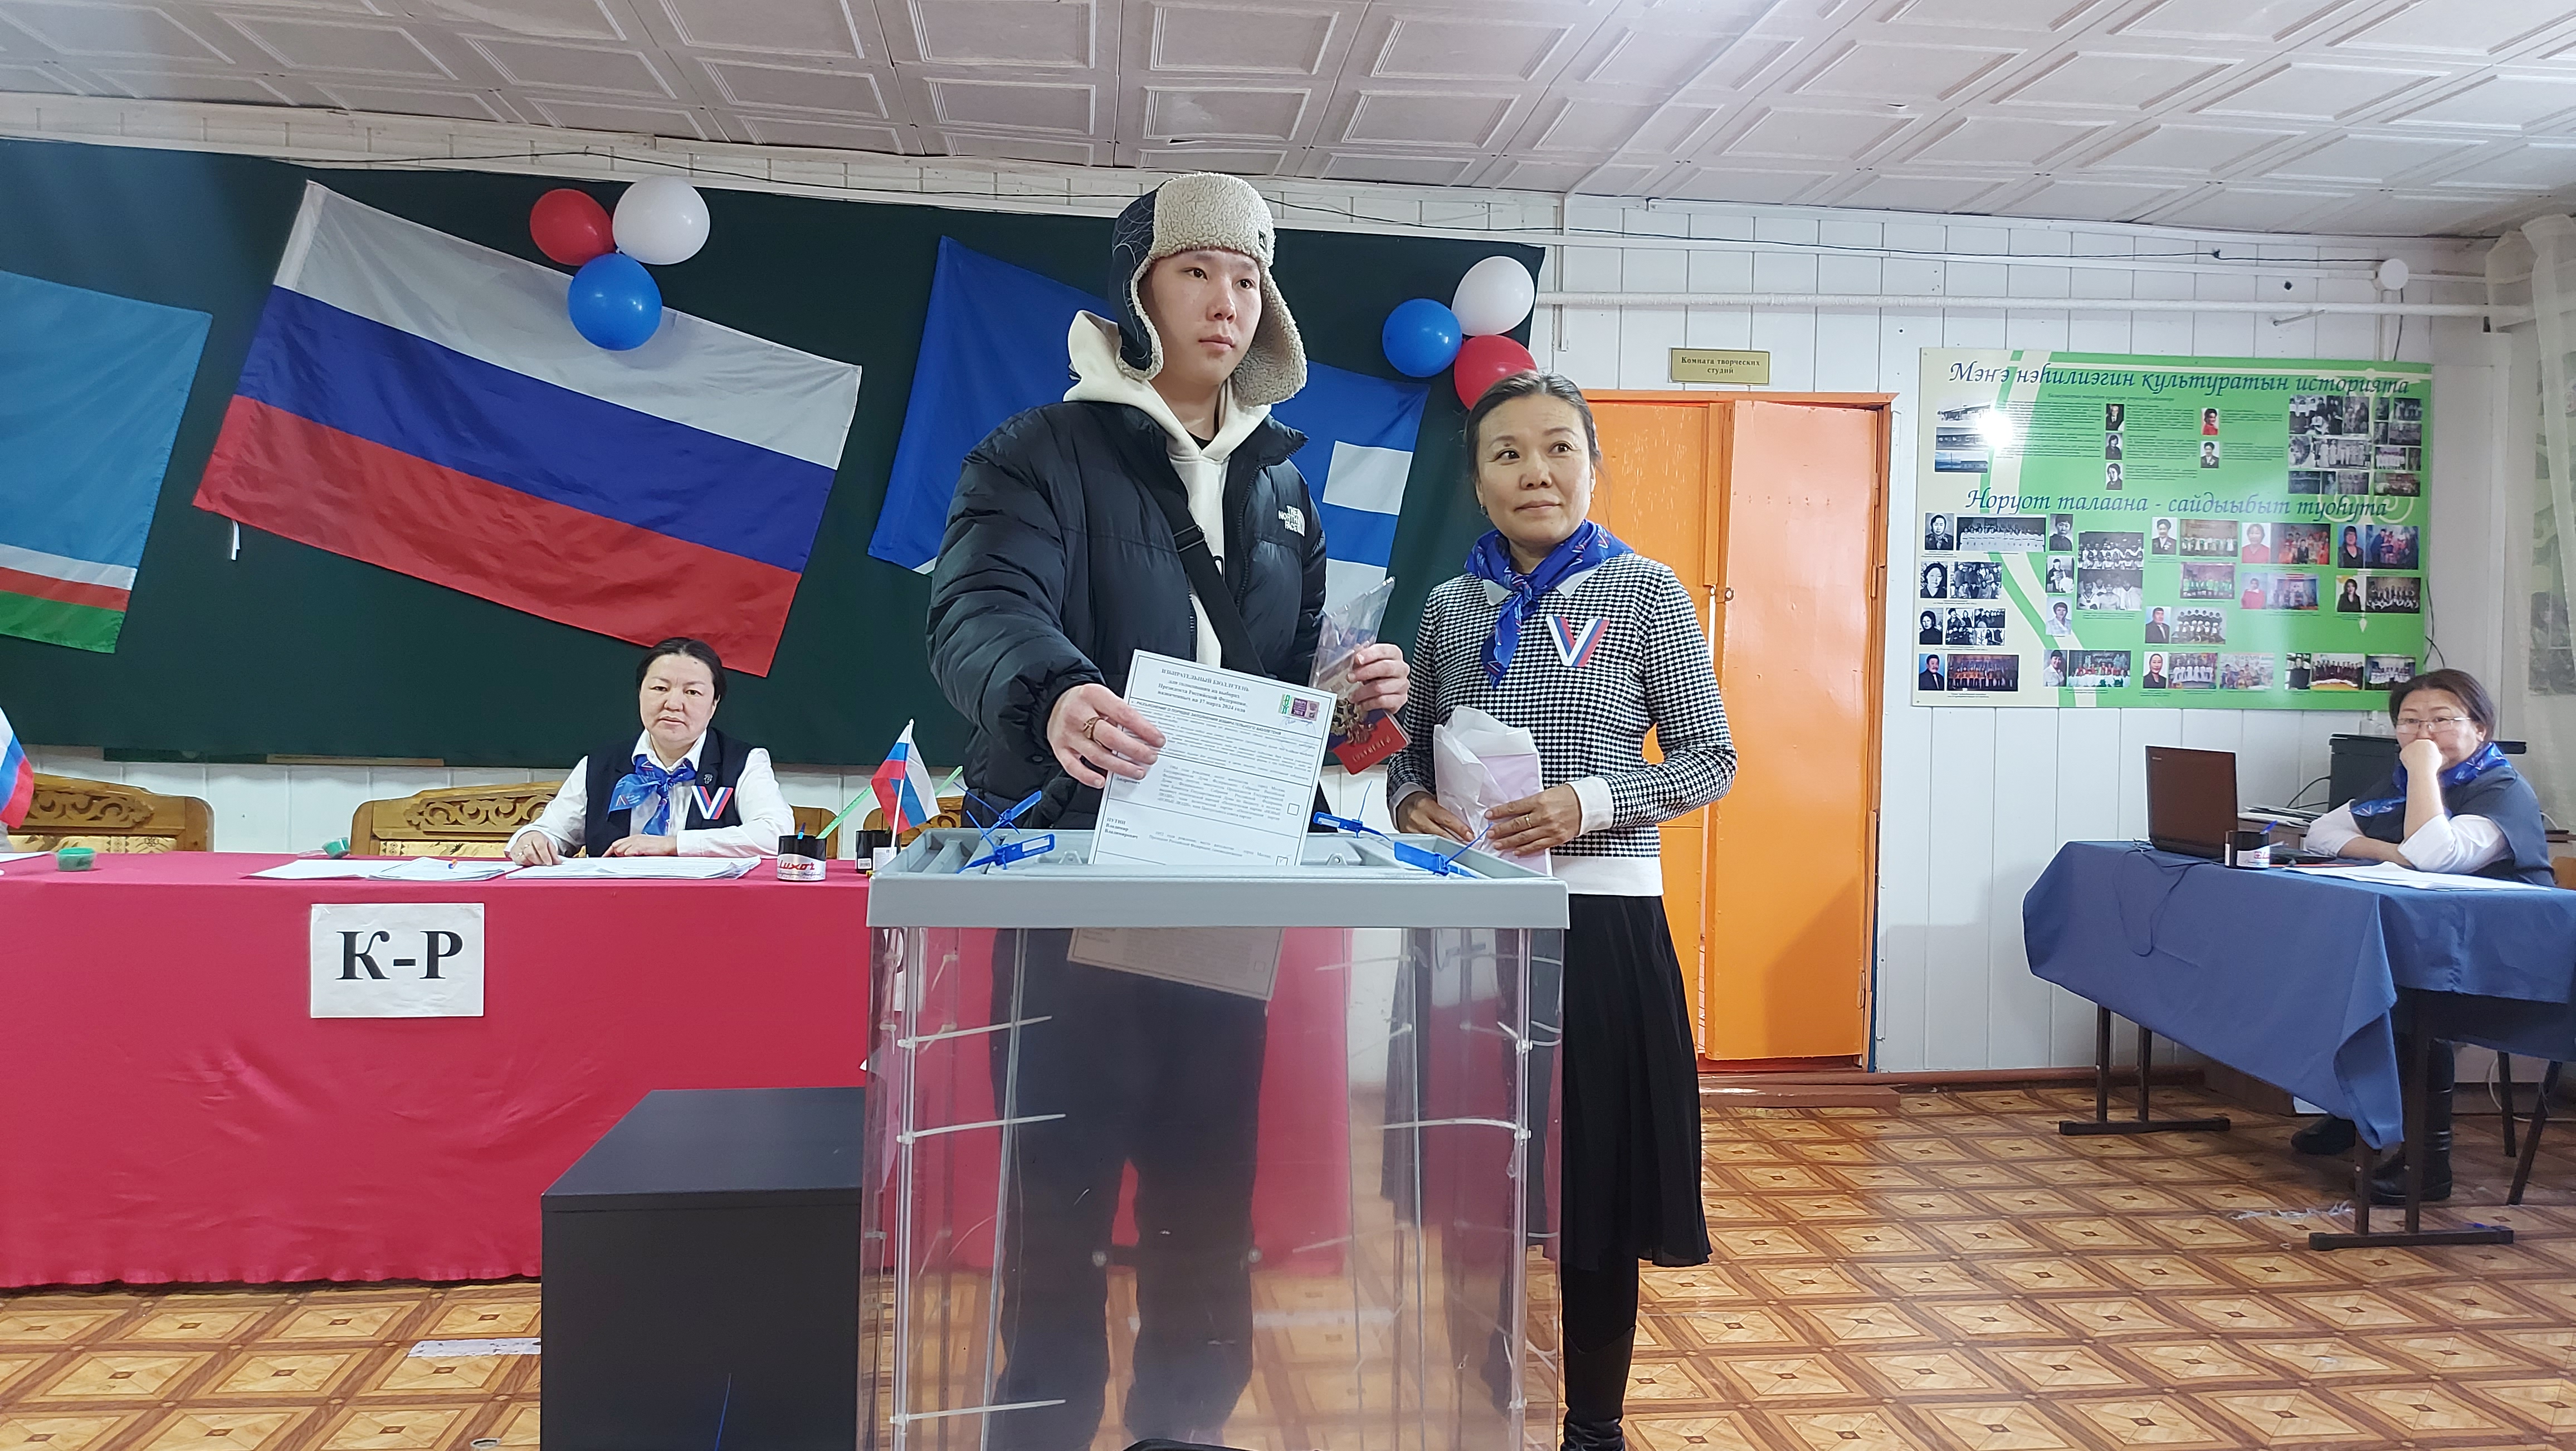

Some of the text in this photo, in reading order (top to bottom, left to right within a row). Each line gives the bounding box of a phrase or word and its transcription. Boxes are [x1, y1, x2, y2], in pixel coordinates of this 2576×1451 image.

[1707, 367, 1734, 375] студий
[2142, 373, 2289, 395] культуратын
[2296, 377, 2408, 395] историята
[1965, 487, 2051, 514] Норуот
[2058, 496, 2148, 512] талаана
[2168, 491, 2290, 514] сайдыыбыт
[1279, 510, 1297, 524] NORTH
[1286, 505, 1297, 515] THE
[1285, 520, 1297, 532] FACE
[335, 931, 464, 980] К-Р
